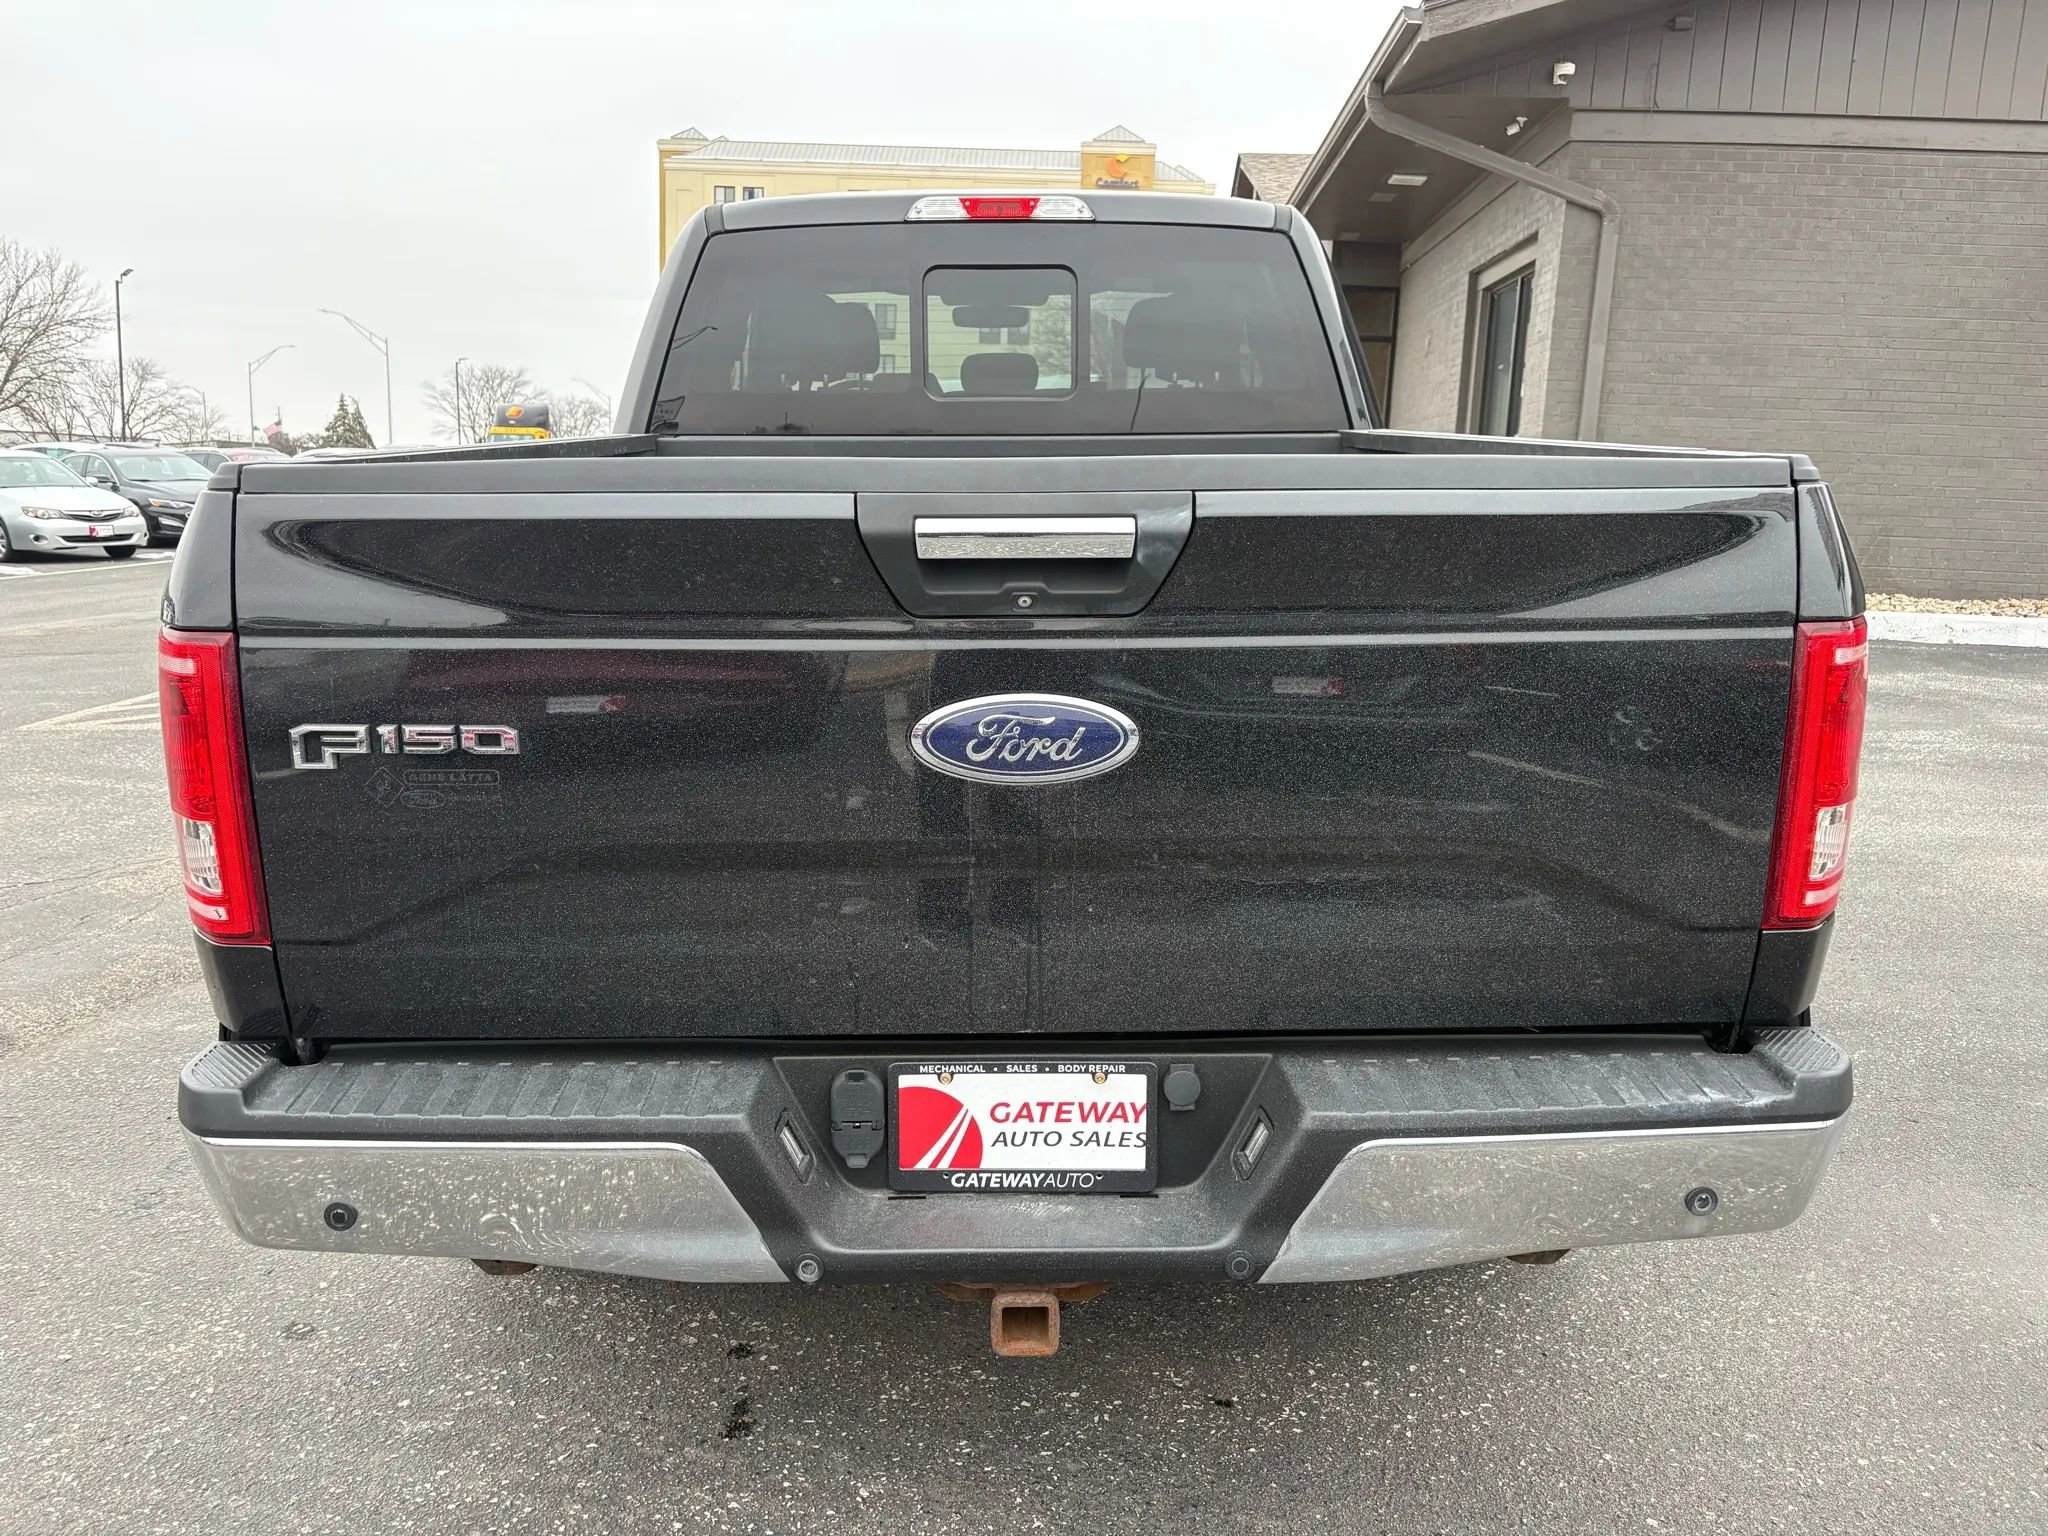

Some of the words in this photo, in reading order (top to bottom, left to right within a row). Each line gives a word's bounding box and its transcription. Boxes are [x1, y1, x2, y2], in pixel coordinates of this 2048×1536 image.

[966, 714, 1087, 762] Ford
[919, 1064, 986, 1073] MECHANICAL
[1006, 1064, 1038, 1073] SALES
[1057, 1064, 1086, 1073] BODY
[1089, 1064, 1126, 1073] REPAIR
[989, 1101, 1148, 1124] GATEWAY
[990, 1131, 1063, 1147] AUTO
[1069, 1131, 1148, 1148] SALES
